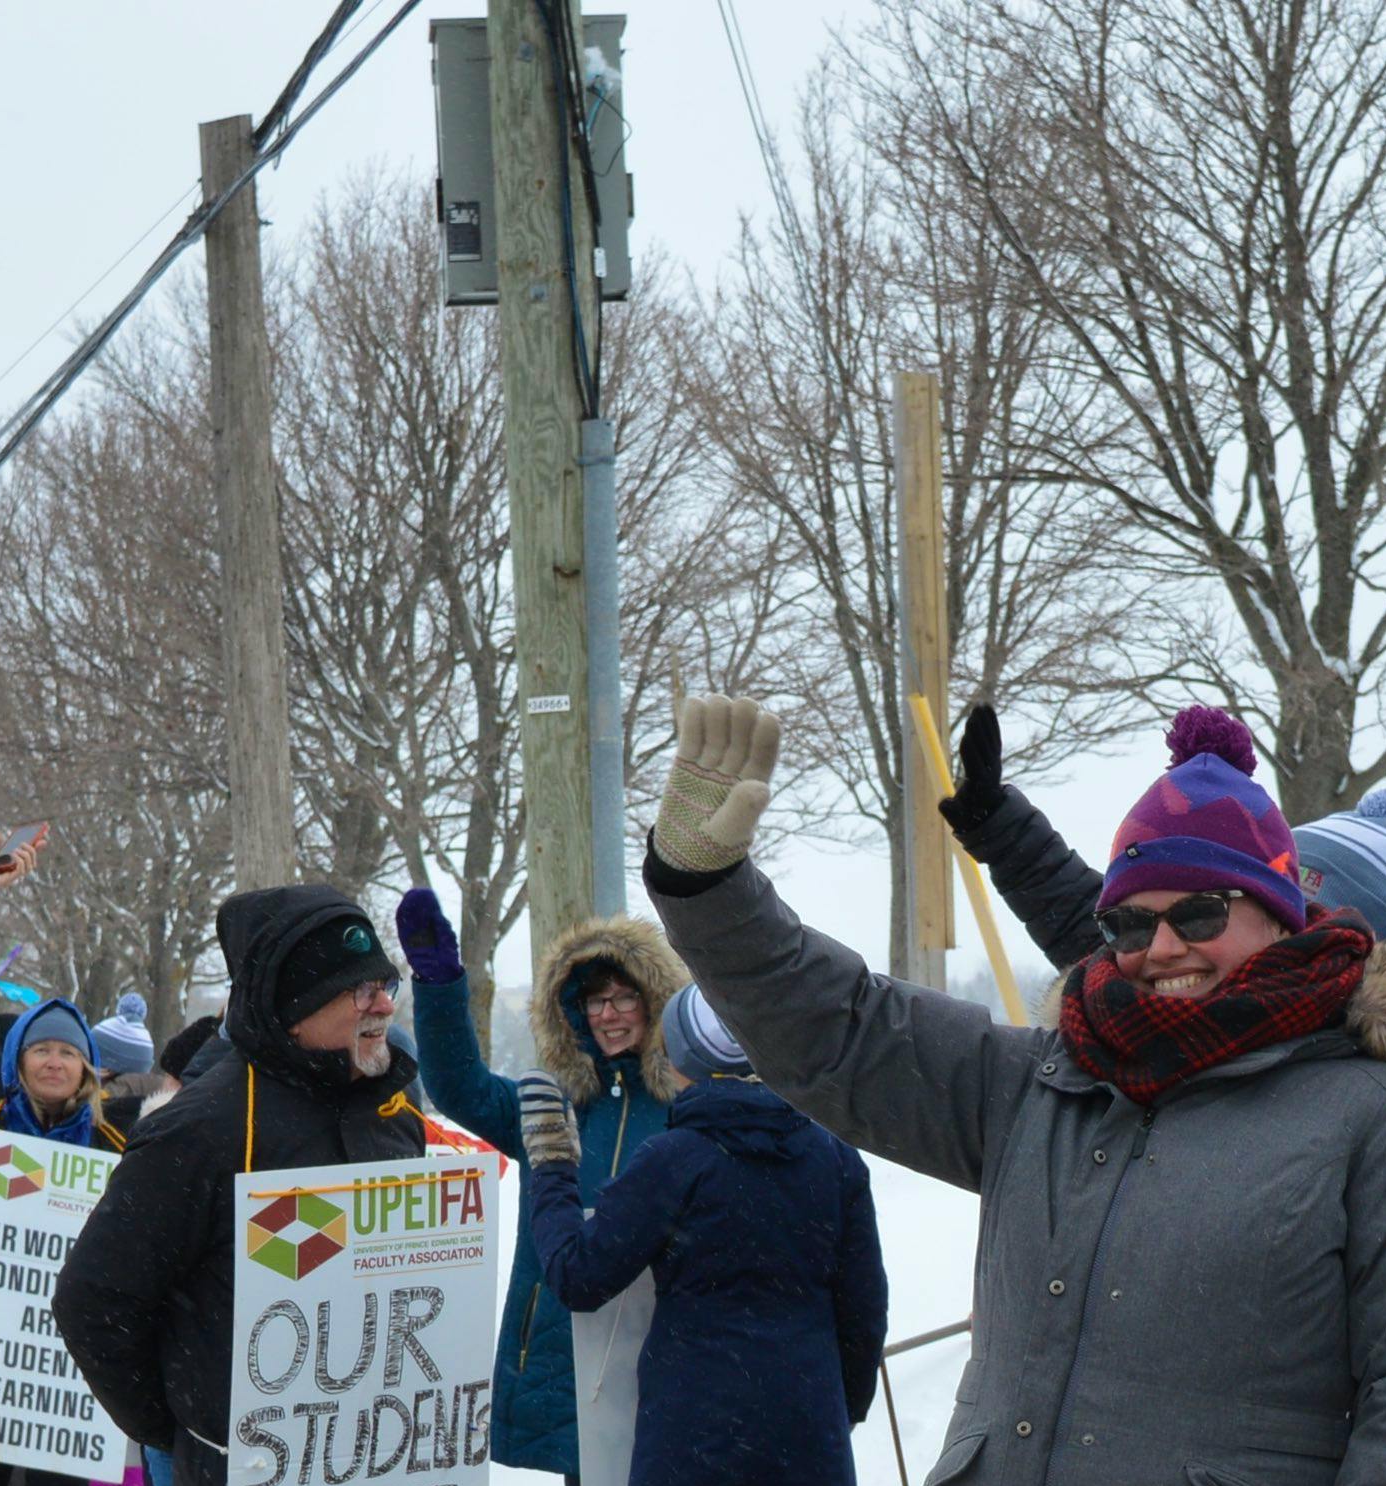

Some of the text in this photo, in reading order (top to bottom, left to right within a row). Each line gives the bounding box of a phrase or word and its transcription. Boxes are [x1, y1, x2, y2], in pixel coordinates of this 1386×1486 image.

[354, 1168, 484, 1235] UPEIFA
[354, 1247, 483, 1270] FACULTY ASSOCIATION
[247, 1286, 444, 1394] OUR
